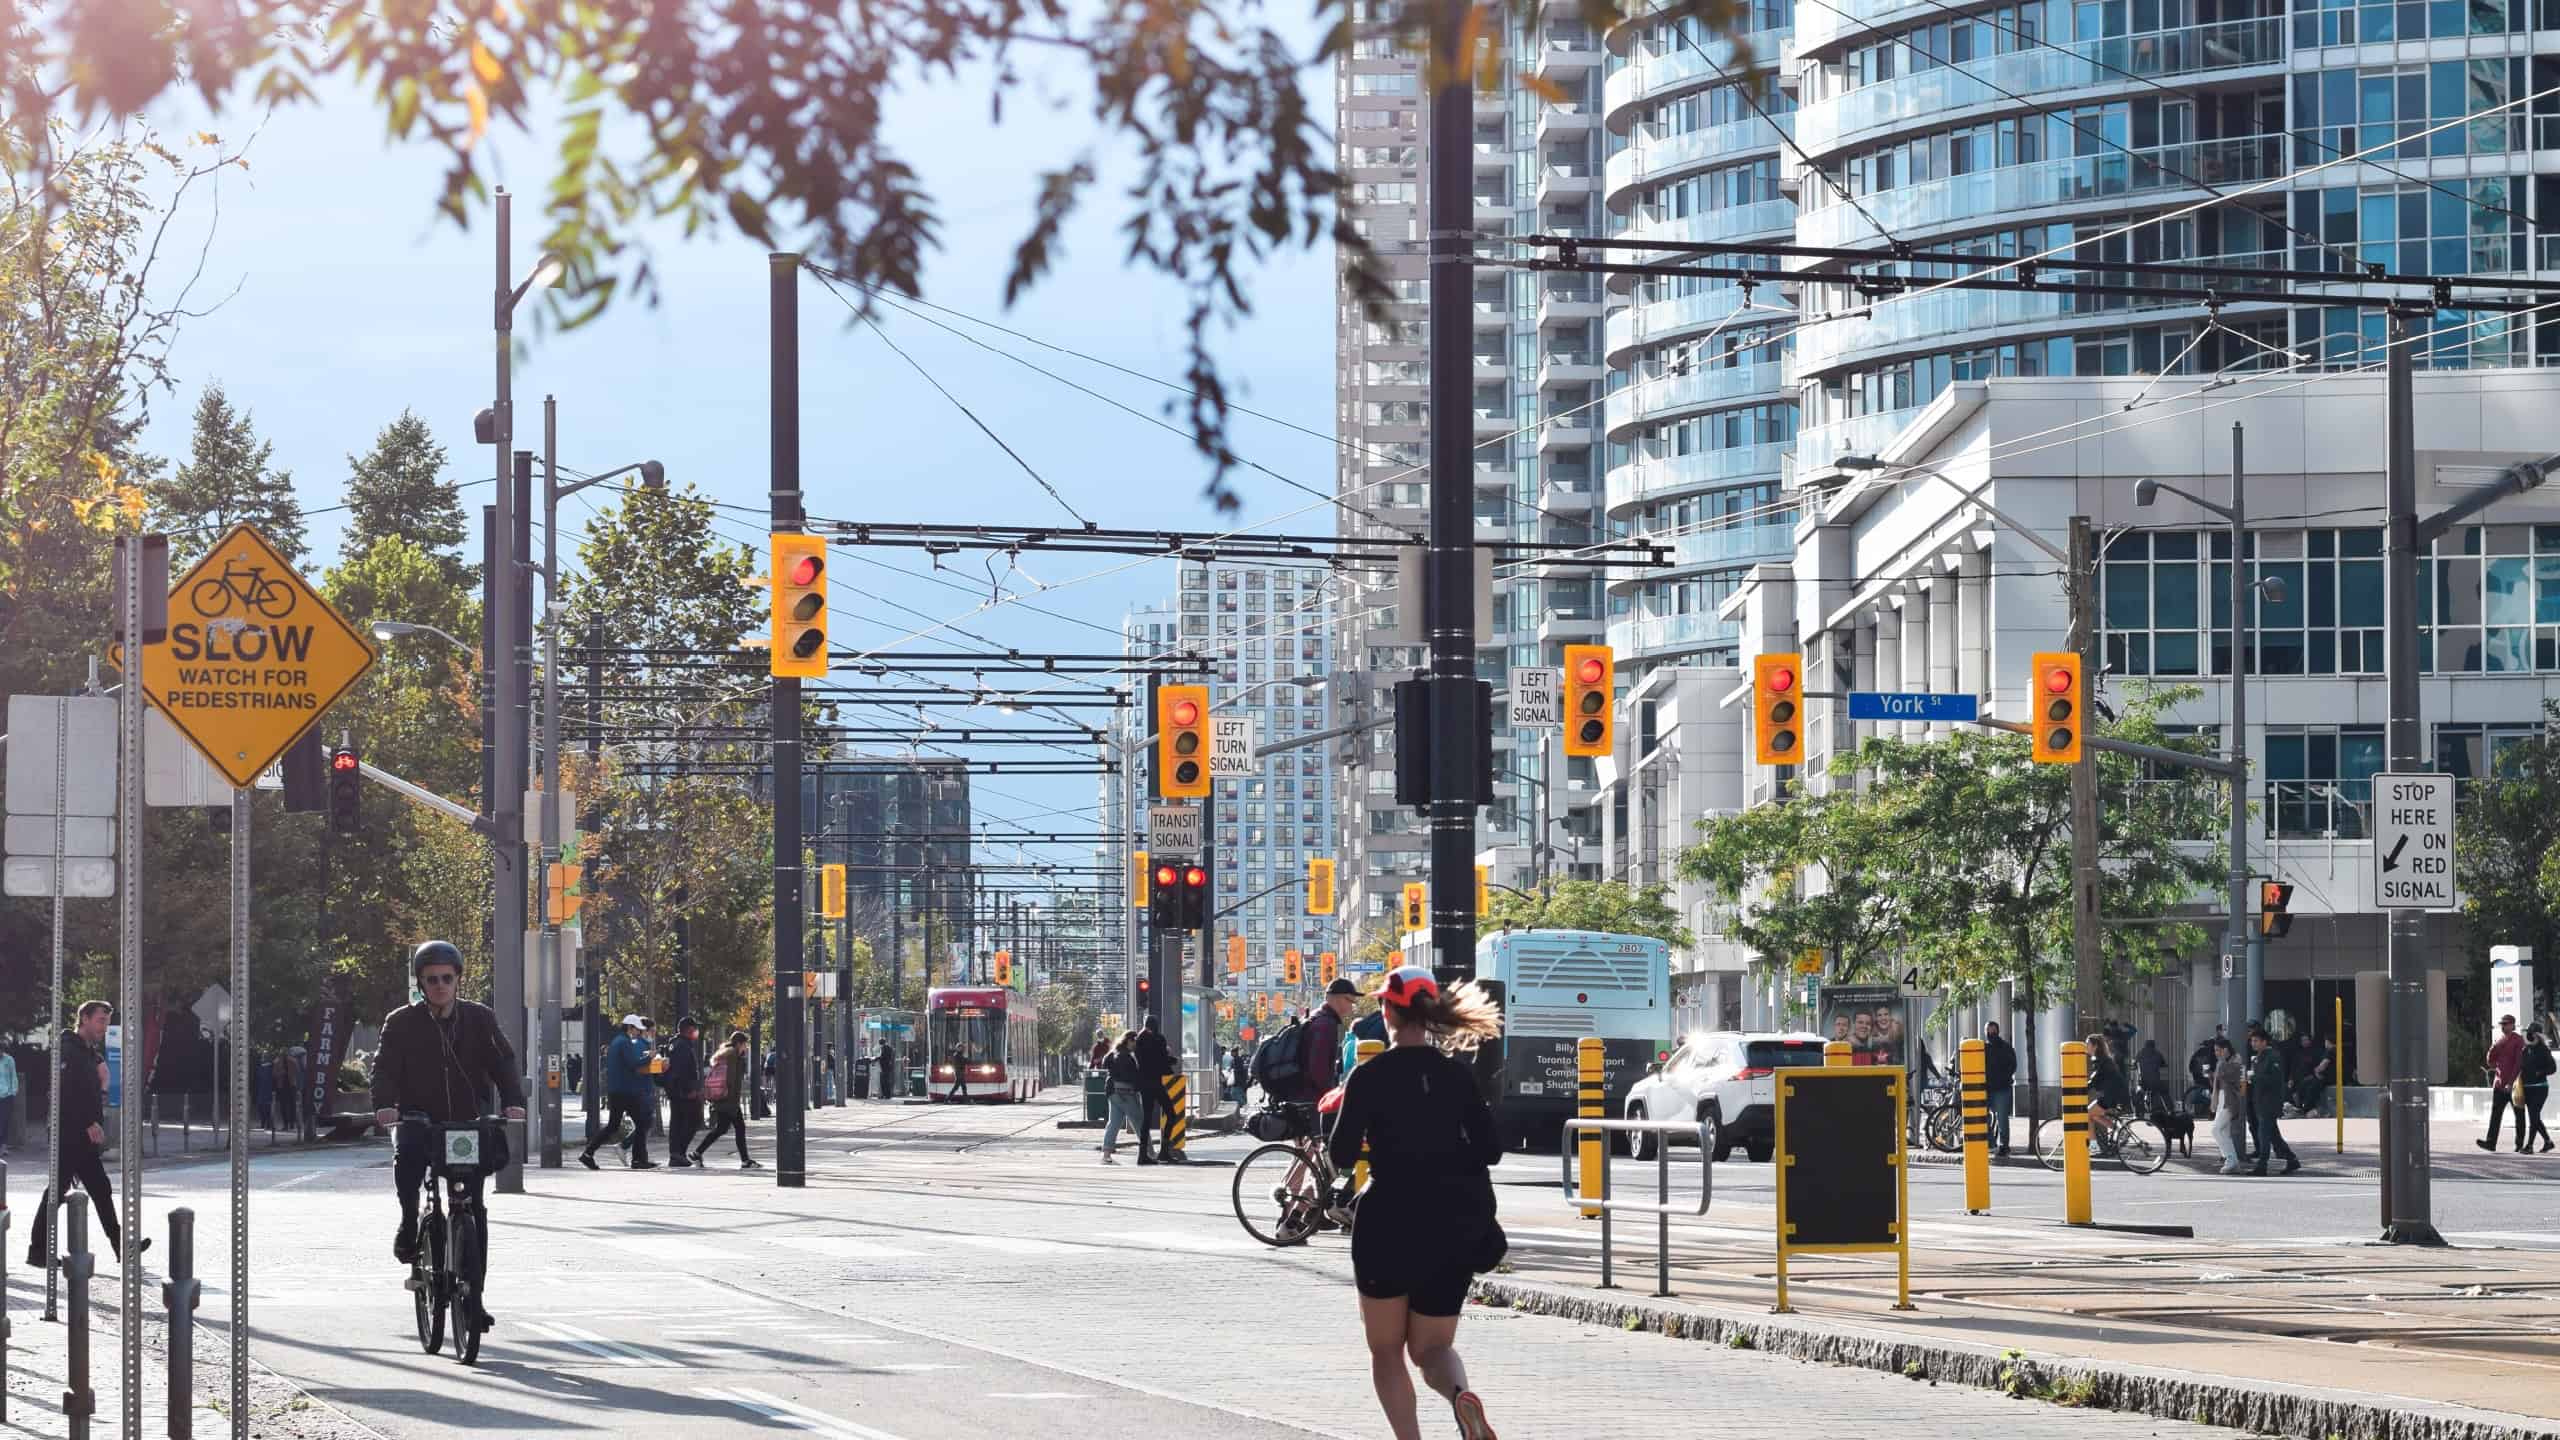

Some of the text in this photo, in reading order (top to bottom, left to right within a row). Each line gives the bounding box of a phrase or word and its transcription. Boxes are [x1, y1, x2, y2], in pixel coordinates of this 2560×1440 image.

[171, 623, 314, 662] SLOW
[179, 668, 307, 687] WATCH FOR
[1520, 672, 1549, 687] LEFT
[167, 691, 317, 709] PEDESTRIANS
[1519, 690, 1550, 704] TURN
[1880, 695, 1942, 714] York St
[1513, 707, 1554, 722] SIGNAL
[1216, 722, 1245, 736] LEFT
[1216, 739, 1247, 754] TURN
[1209, 757, 1251, 772] SIGNAL
[2392, 784, 2435, 801] STOP
[1153, 813, 1197, 828] TRANSIT
[2391, 809, 2436, 825] HERE
[1155, 833, 1195, 848] SIGNAL
[2423, 833, 2446, 849] ON
[2412, 857, 2447, 874] RED
[2384, 881, 2447, 898] SIGNAL
[1616, 943, 1646, 954] 2807
[316, 1007, 335, 1065] FARM
[1555, 1042, 1575, 1054] Billy
[1537, 1055, 1572, 1065] Toronto
[313, 1071, 326, 1114] BOY
